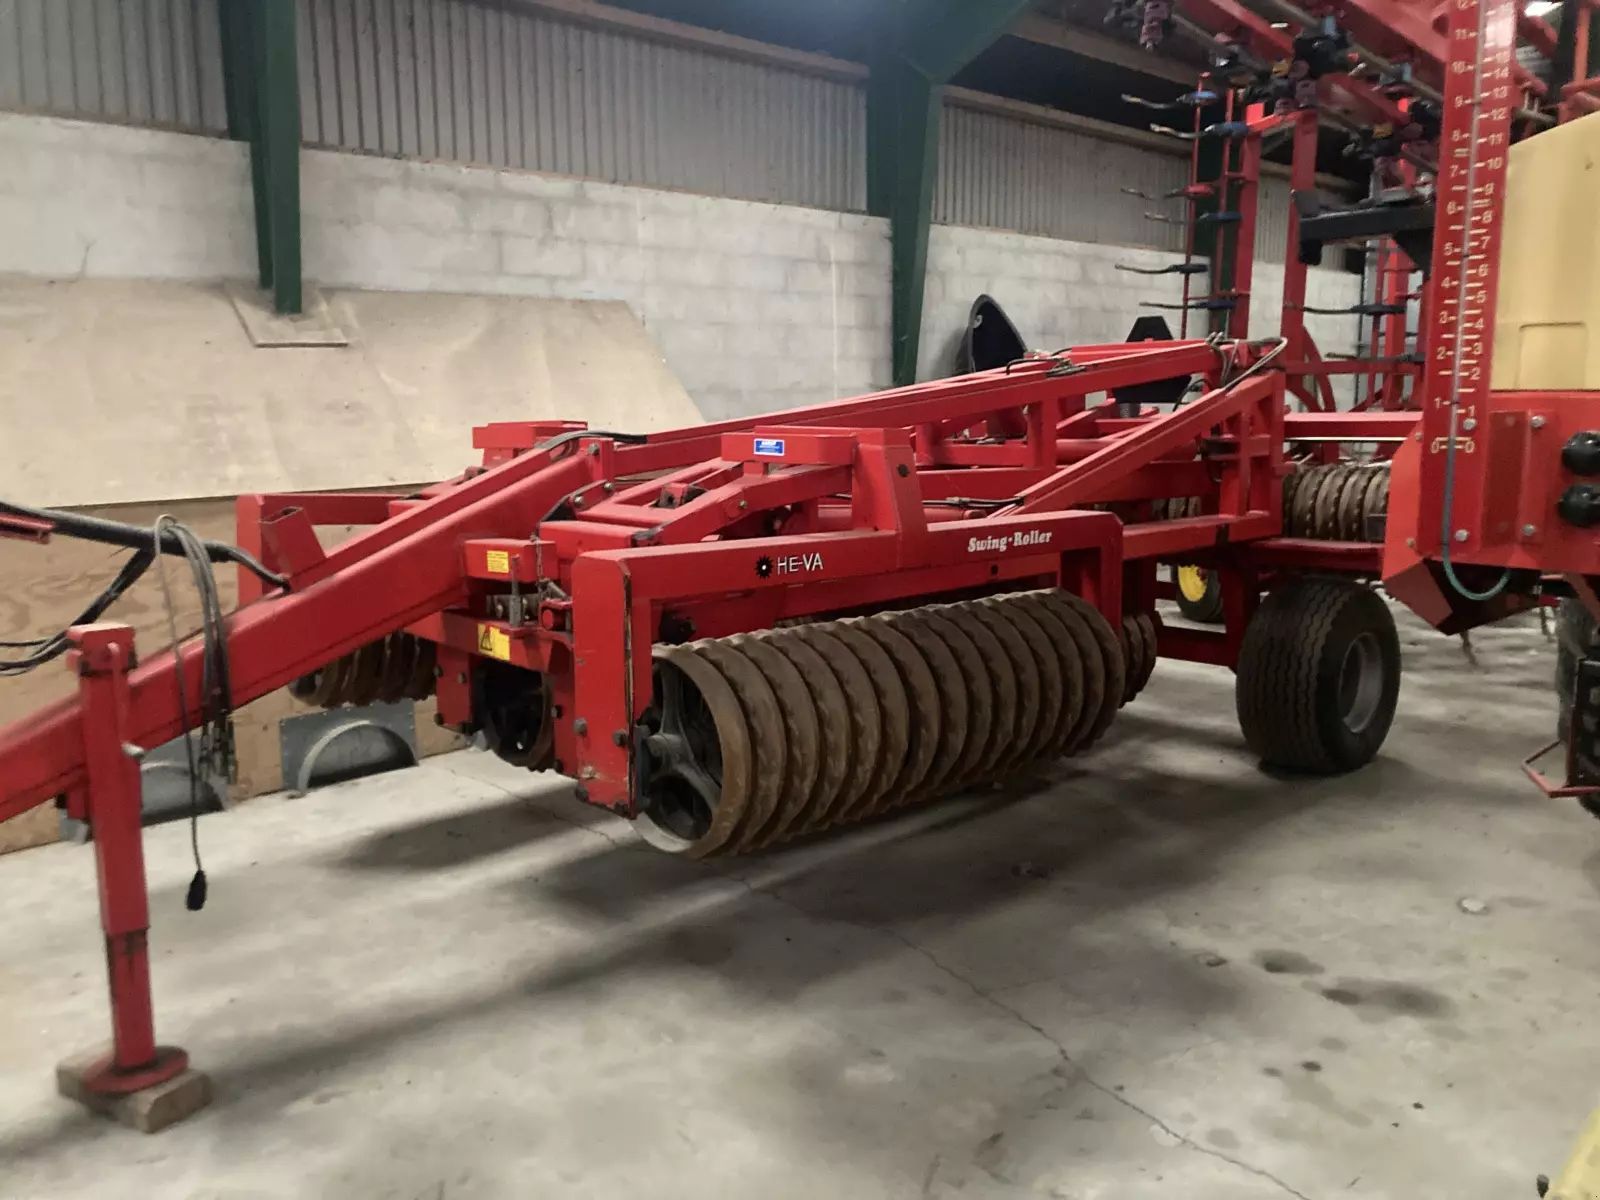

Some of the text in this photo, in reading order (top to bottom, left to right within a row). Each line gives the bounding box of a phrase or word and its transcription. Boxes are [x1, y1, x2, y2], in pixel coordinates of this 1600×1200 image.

[1491, 106, 1507, 120] 12
[1452, 129, 1460, 142] 8
[1488, 132, 1503, 146] 11
[1487, 156, 1503, 170] 10
[1450, 165, 1458, 178] 7
[1484, 182, 1494, 196] 9
[1444, 242, 1453, 256] 5
[1481, 235, 1491, 249] 7
[1478, 263, 1489, 277] 6
[1441, 276, 1450, 288] 4
[1477, 289, 1487, 304] 5
[1440, 311, 1448, 324] 3
[1474, 317, 1484, 330] 4
[1436, 346, 1446, 360] 2
[1472, 342, 1483, 355] 3
[1470, 367, 1480, 380] 2
[1434, 397, 1441, 409] 1
[1468, 404, 1475, 417] 1
[1430, 440, 1440, 454] 0
[1464, 440, 1475, 453] 0
[777, 552, 824, 576] HE-VA
